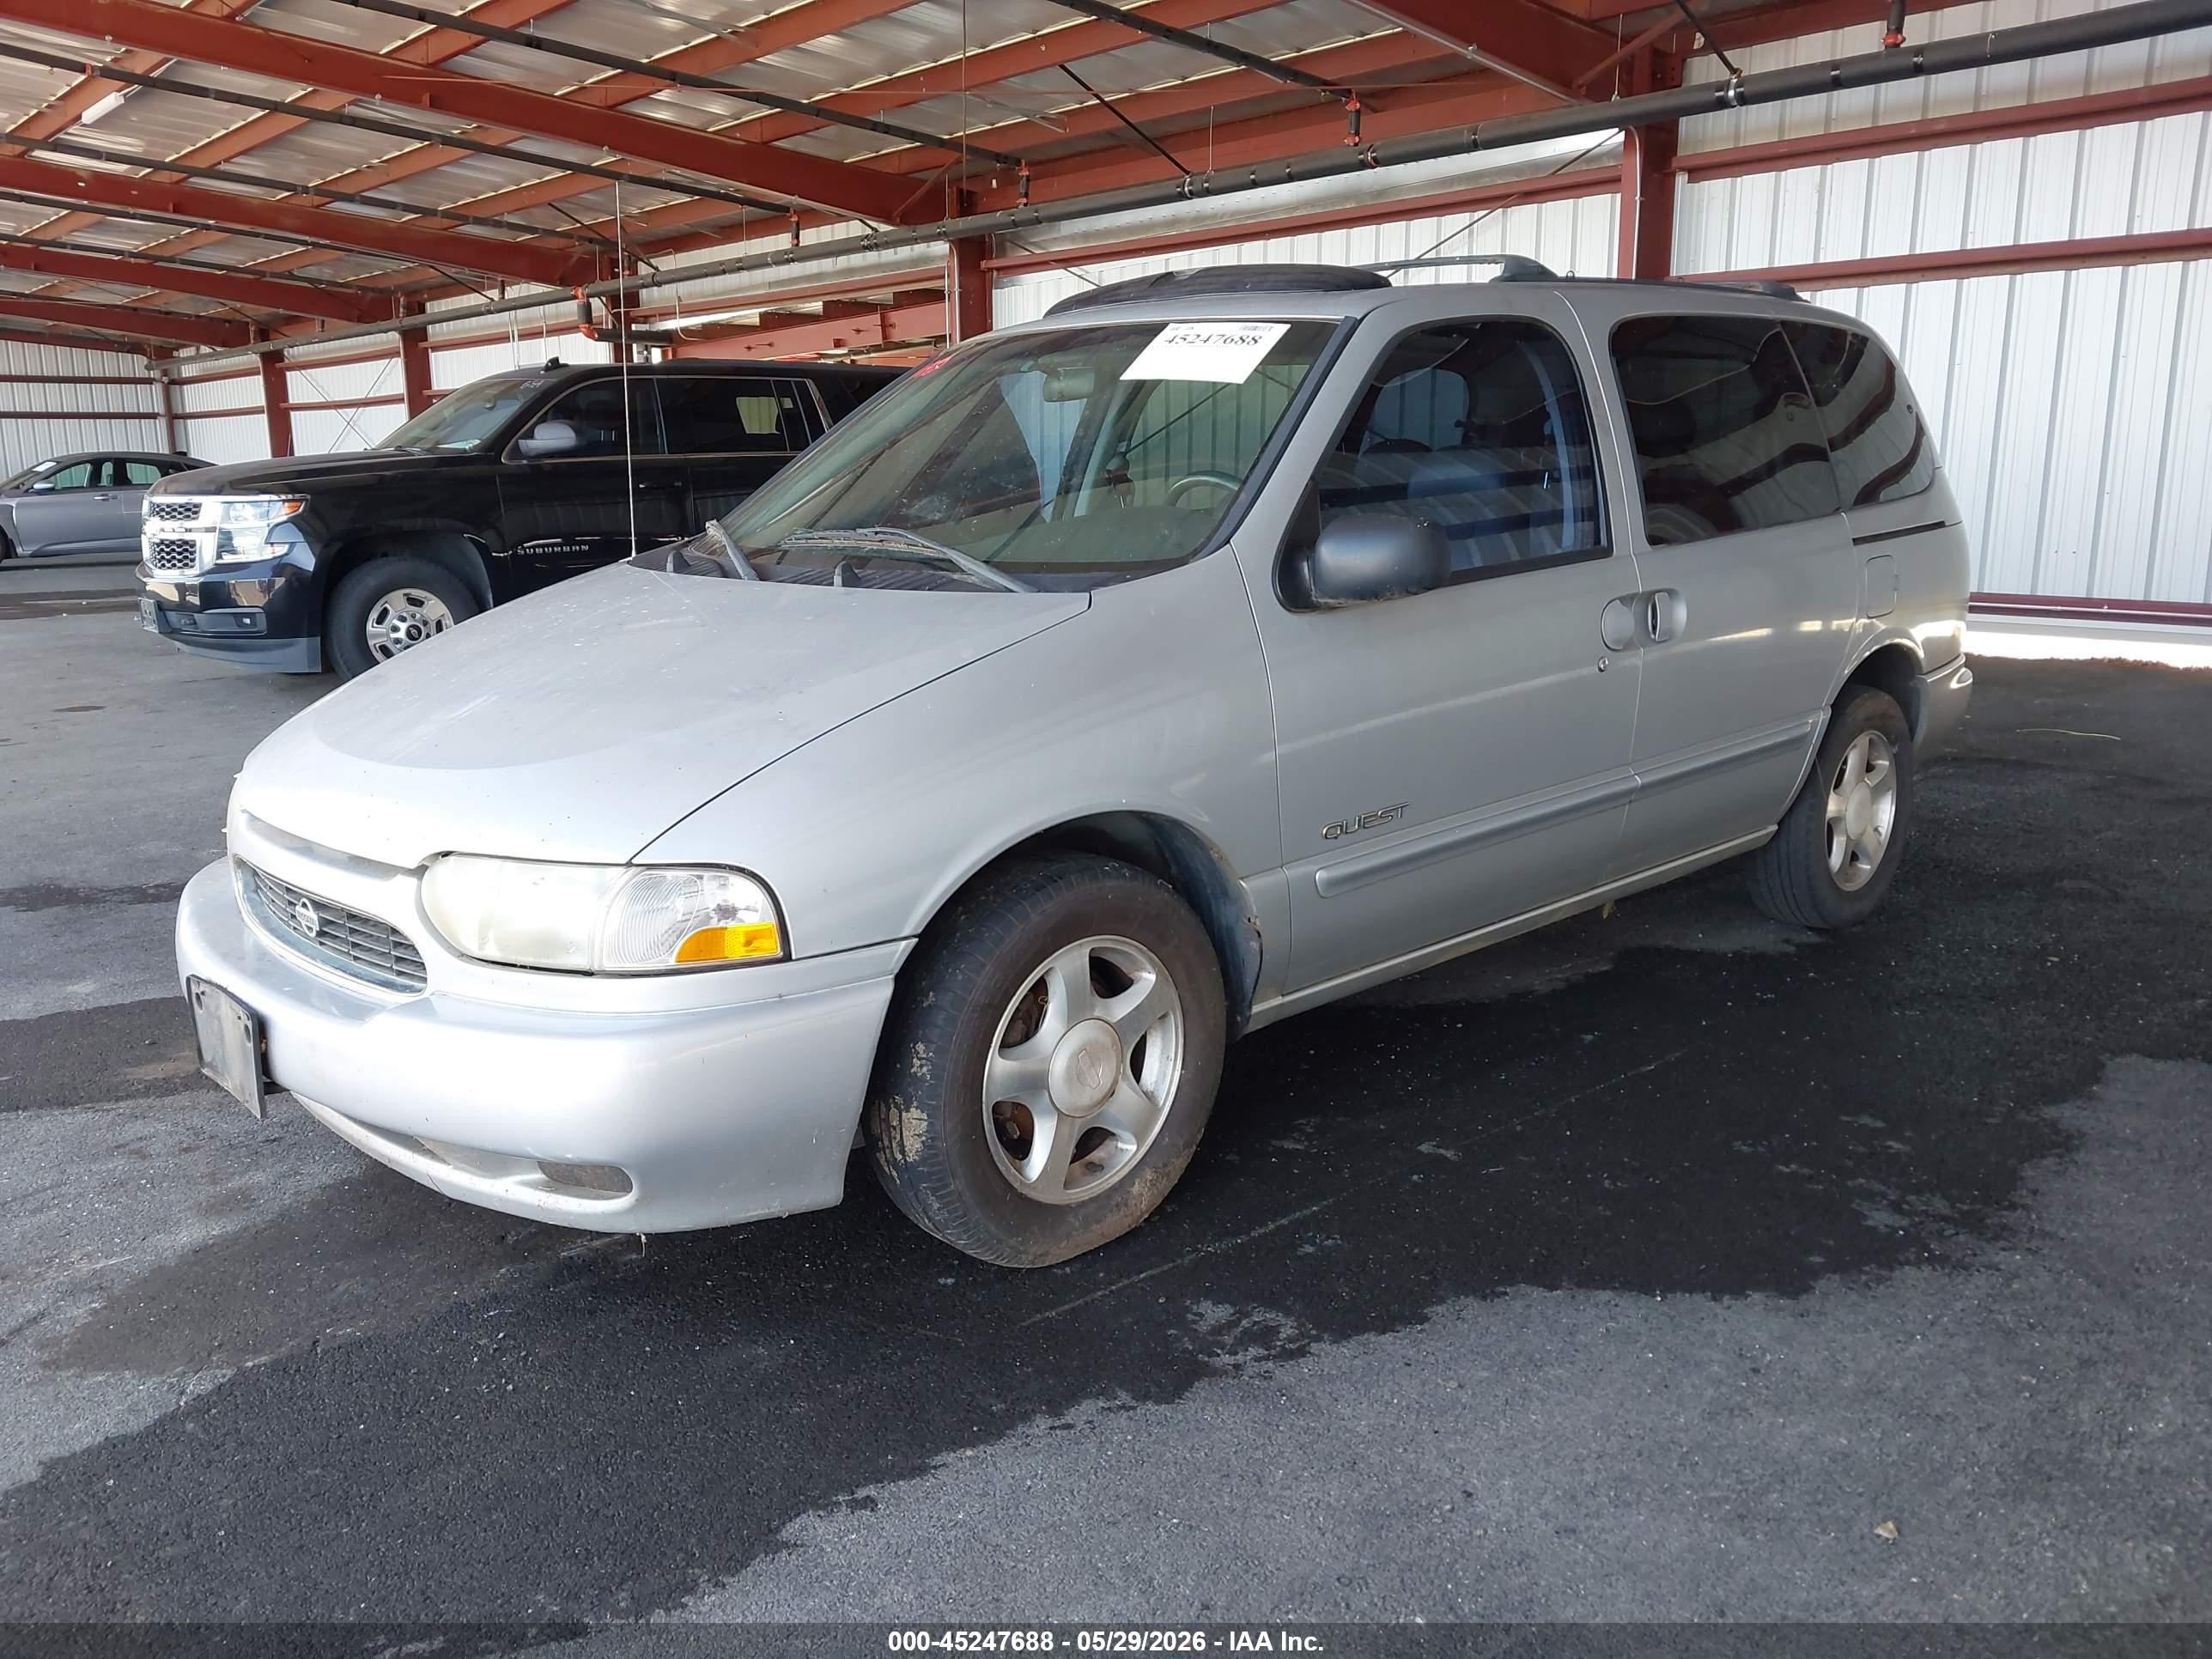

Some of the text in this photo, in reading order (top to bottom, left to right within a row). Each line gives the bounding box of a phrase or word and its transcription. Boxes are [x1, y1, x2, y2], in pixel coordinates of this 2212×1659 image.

[1164, 334, 1262, 345] 45247688
[517, 544, 589, 555] SUBURBAN
[1322, 802, 1410, 839] QUEST
